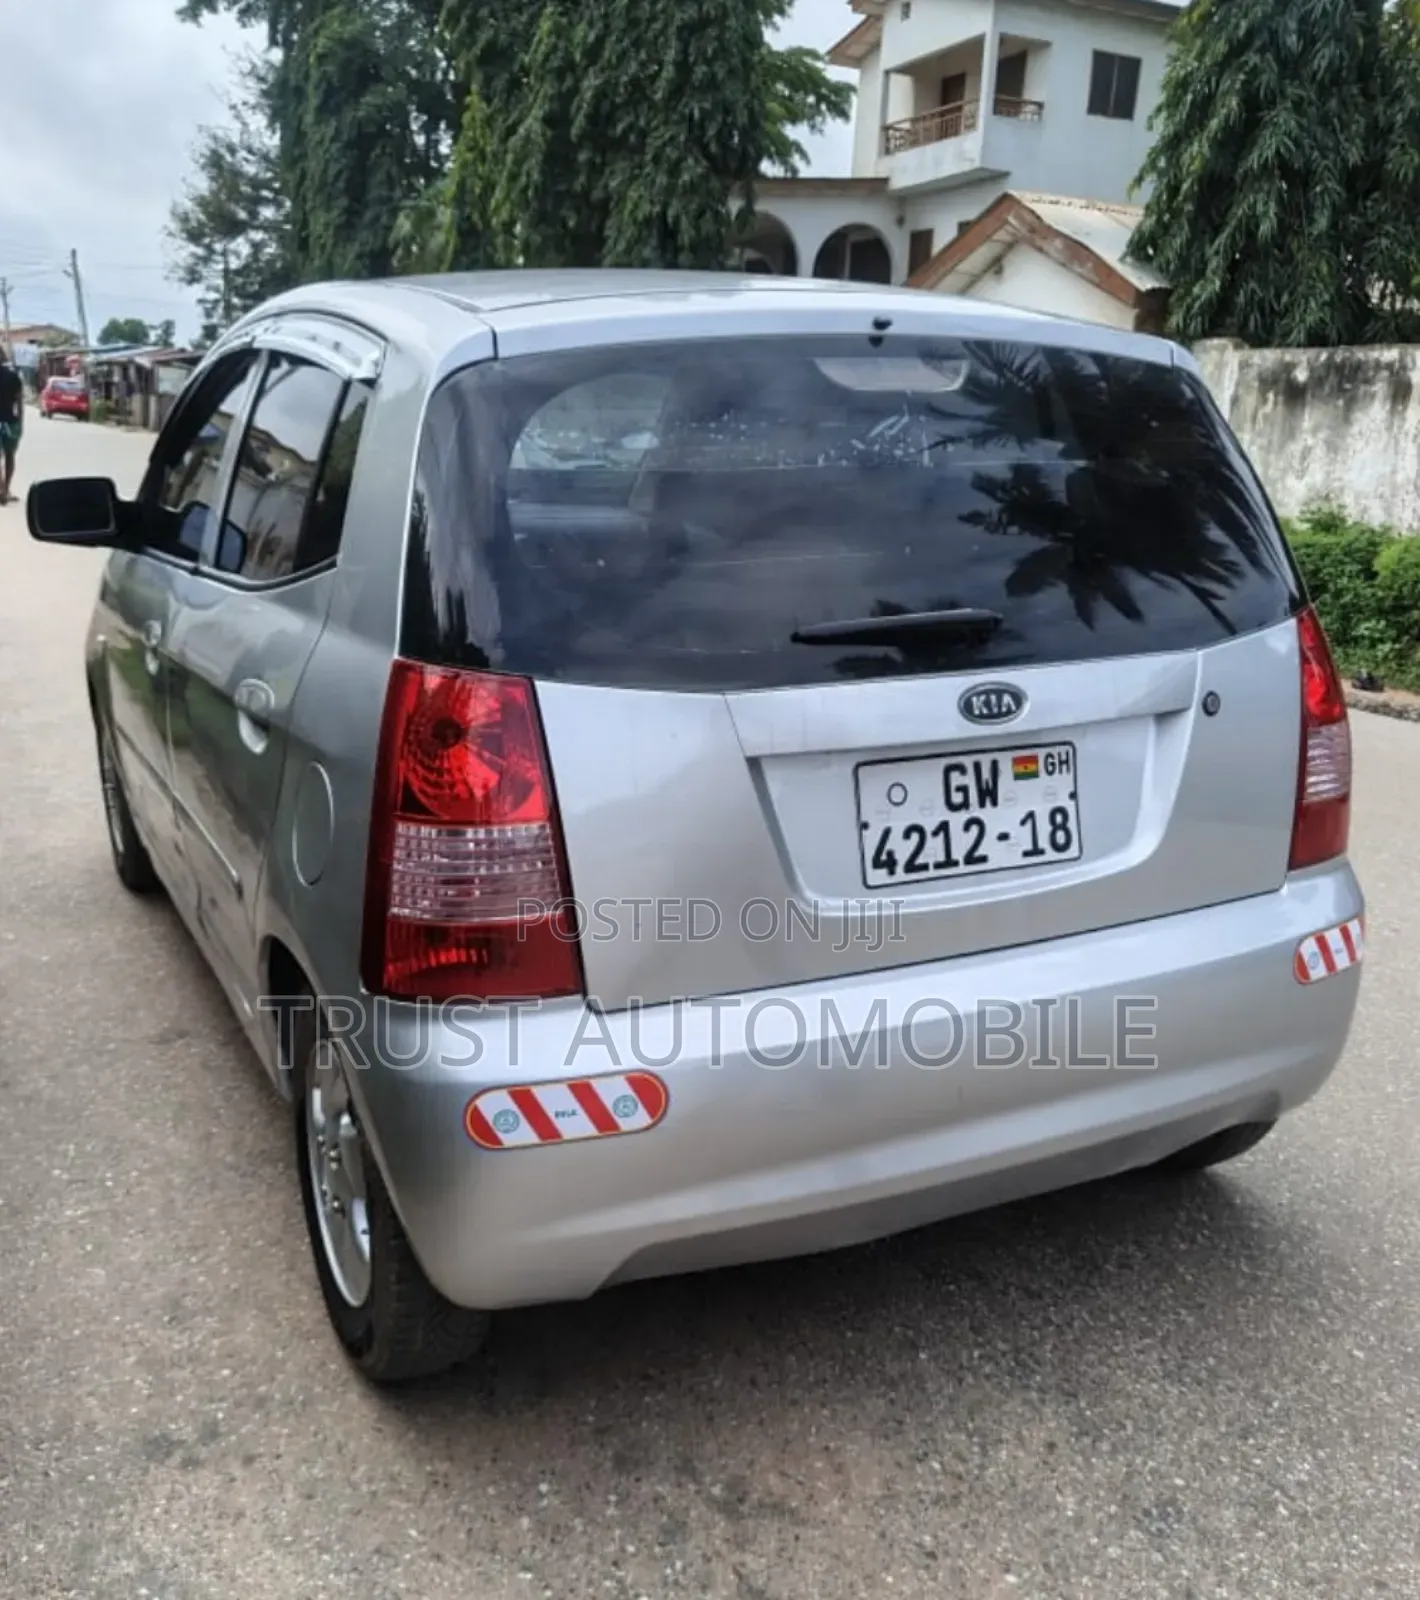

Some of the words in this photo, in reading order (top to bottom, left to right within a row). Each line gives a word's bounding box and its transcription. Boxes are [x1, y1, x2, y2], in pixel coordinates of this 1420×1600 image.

[970, 692, 1017, 717] KIA
[943, 759, 999, 812] GW
[1044, 752, 1071, 776] GH
[872, 806, 1073, 876] 4212-18
